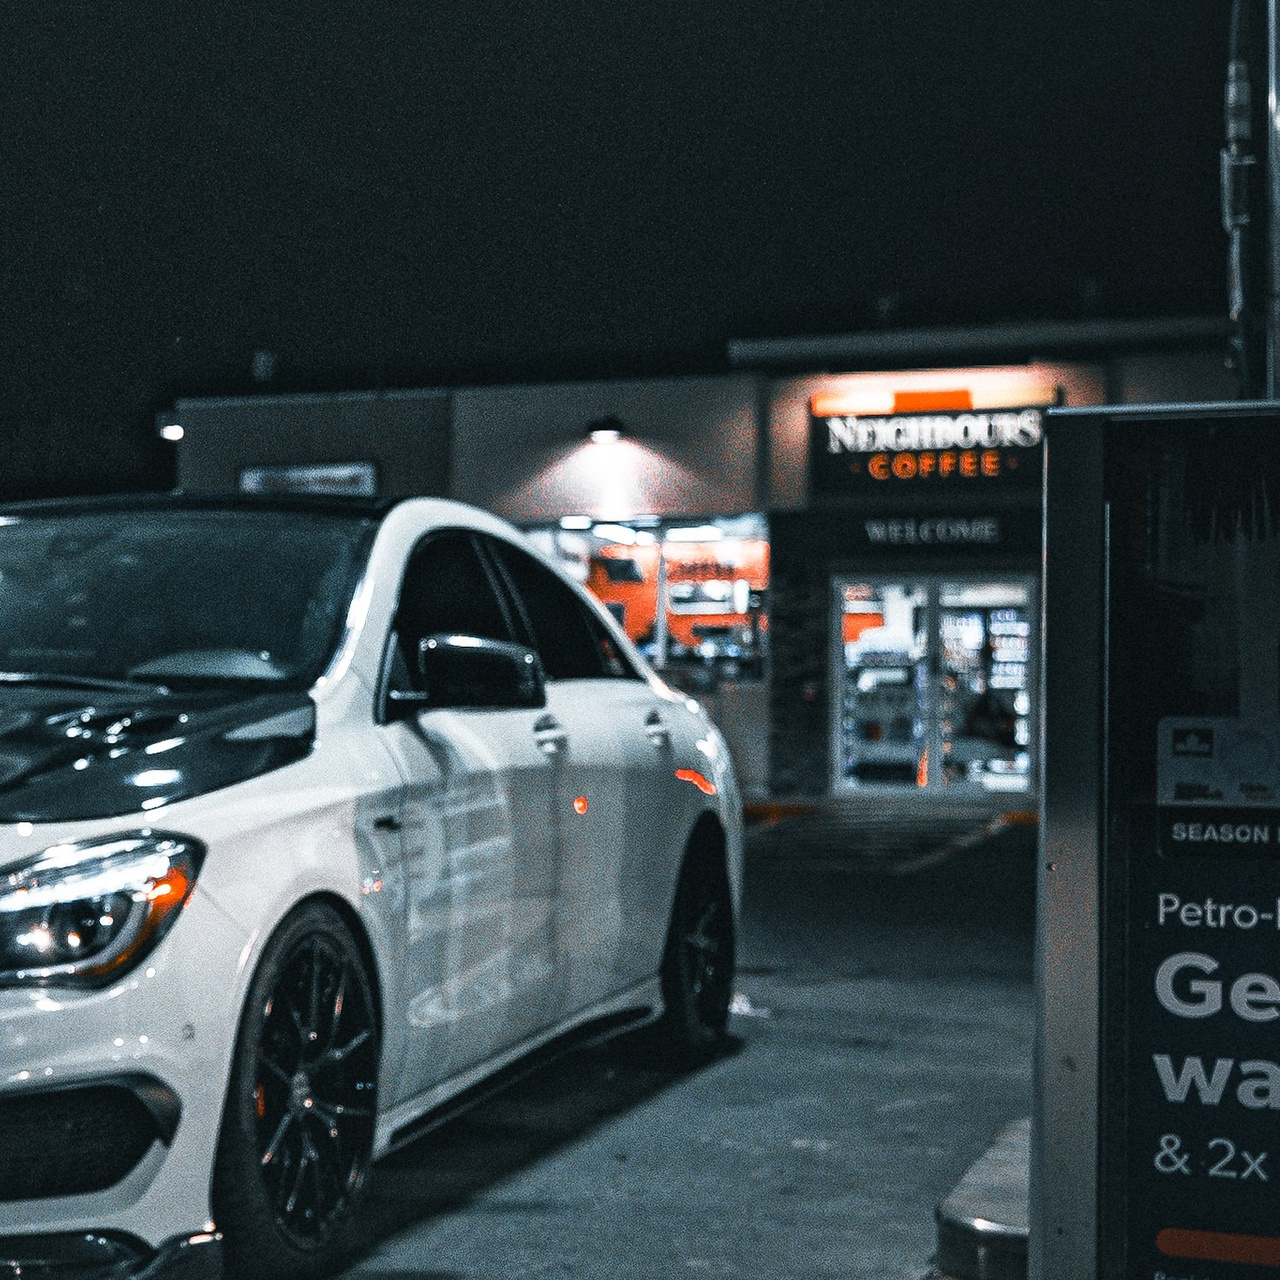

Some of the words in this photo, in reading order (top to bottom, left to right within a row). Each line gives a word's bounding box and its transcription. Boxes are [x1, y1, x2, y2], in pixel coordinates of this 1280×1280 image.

[867, 451, 1001, 481] COFFEE
[865, 519, 999, 542] WELCOME
[1172, 822, 1269, 843] SEASON
[1158, 892, 1280, 930] Petro-
[1154, 951, 1280, 1021] Ge
[1152, 1053, 1280, 1110] wa
[1154, 1133, 1191, 1176] &
[1207, 1137, 1269, 1182] 2x
